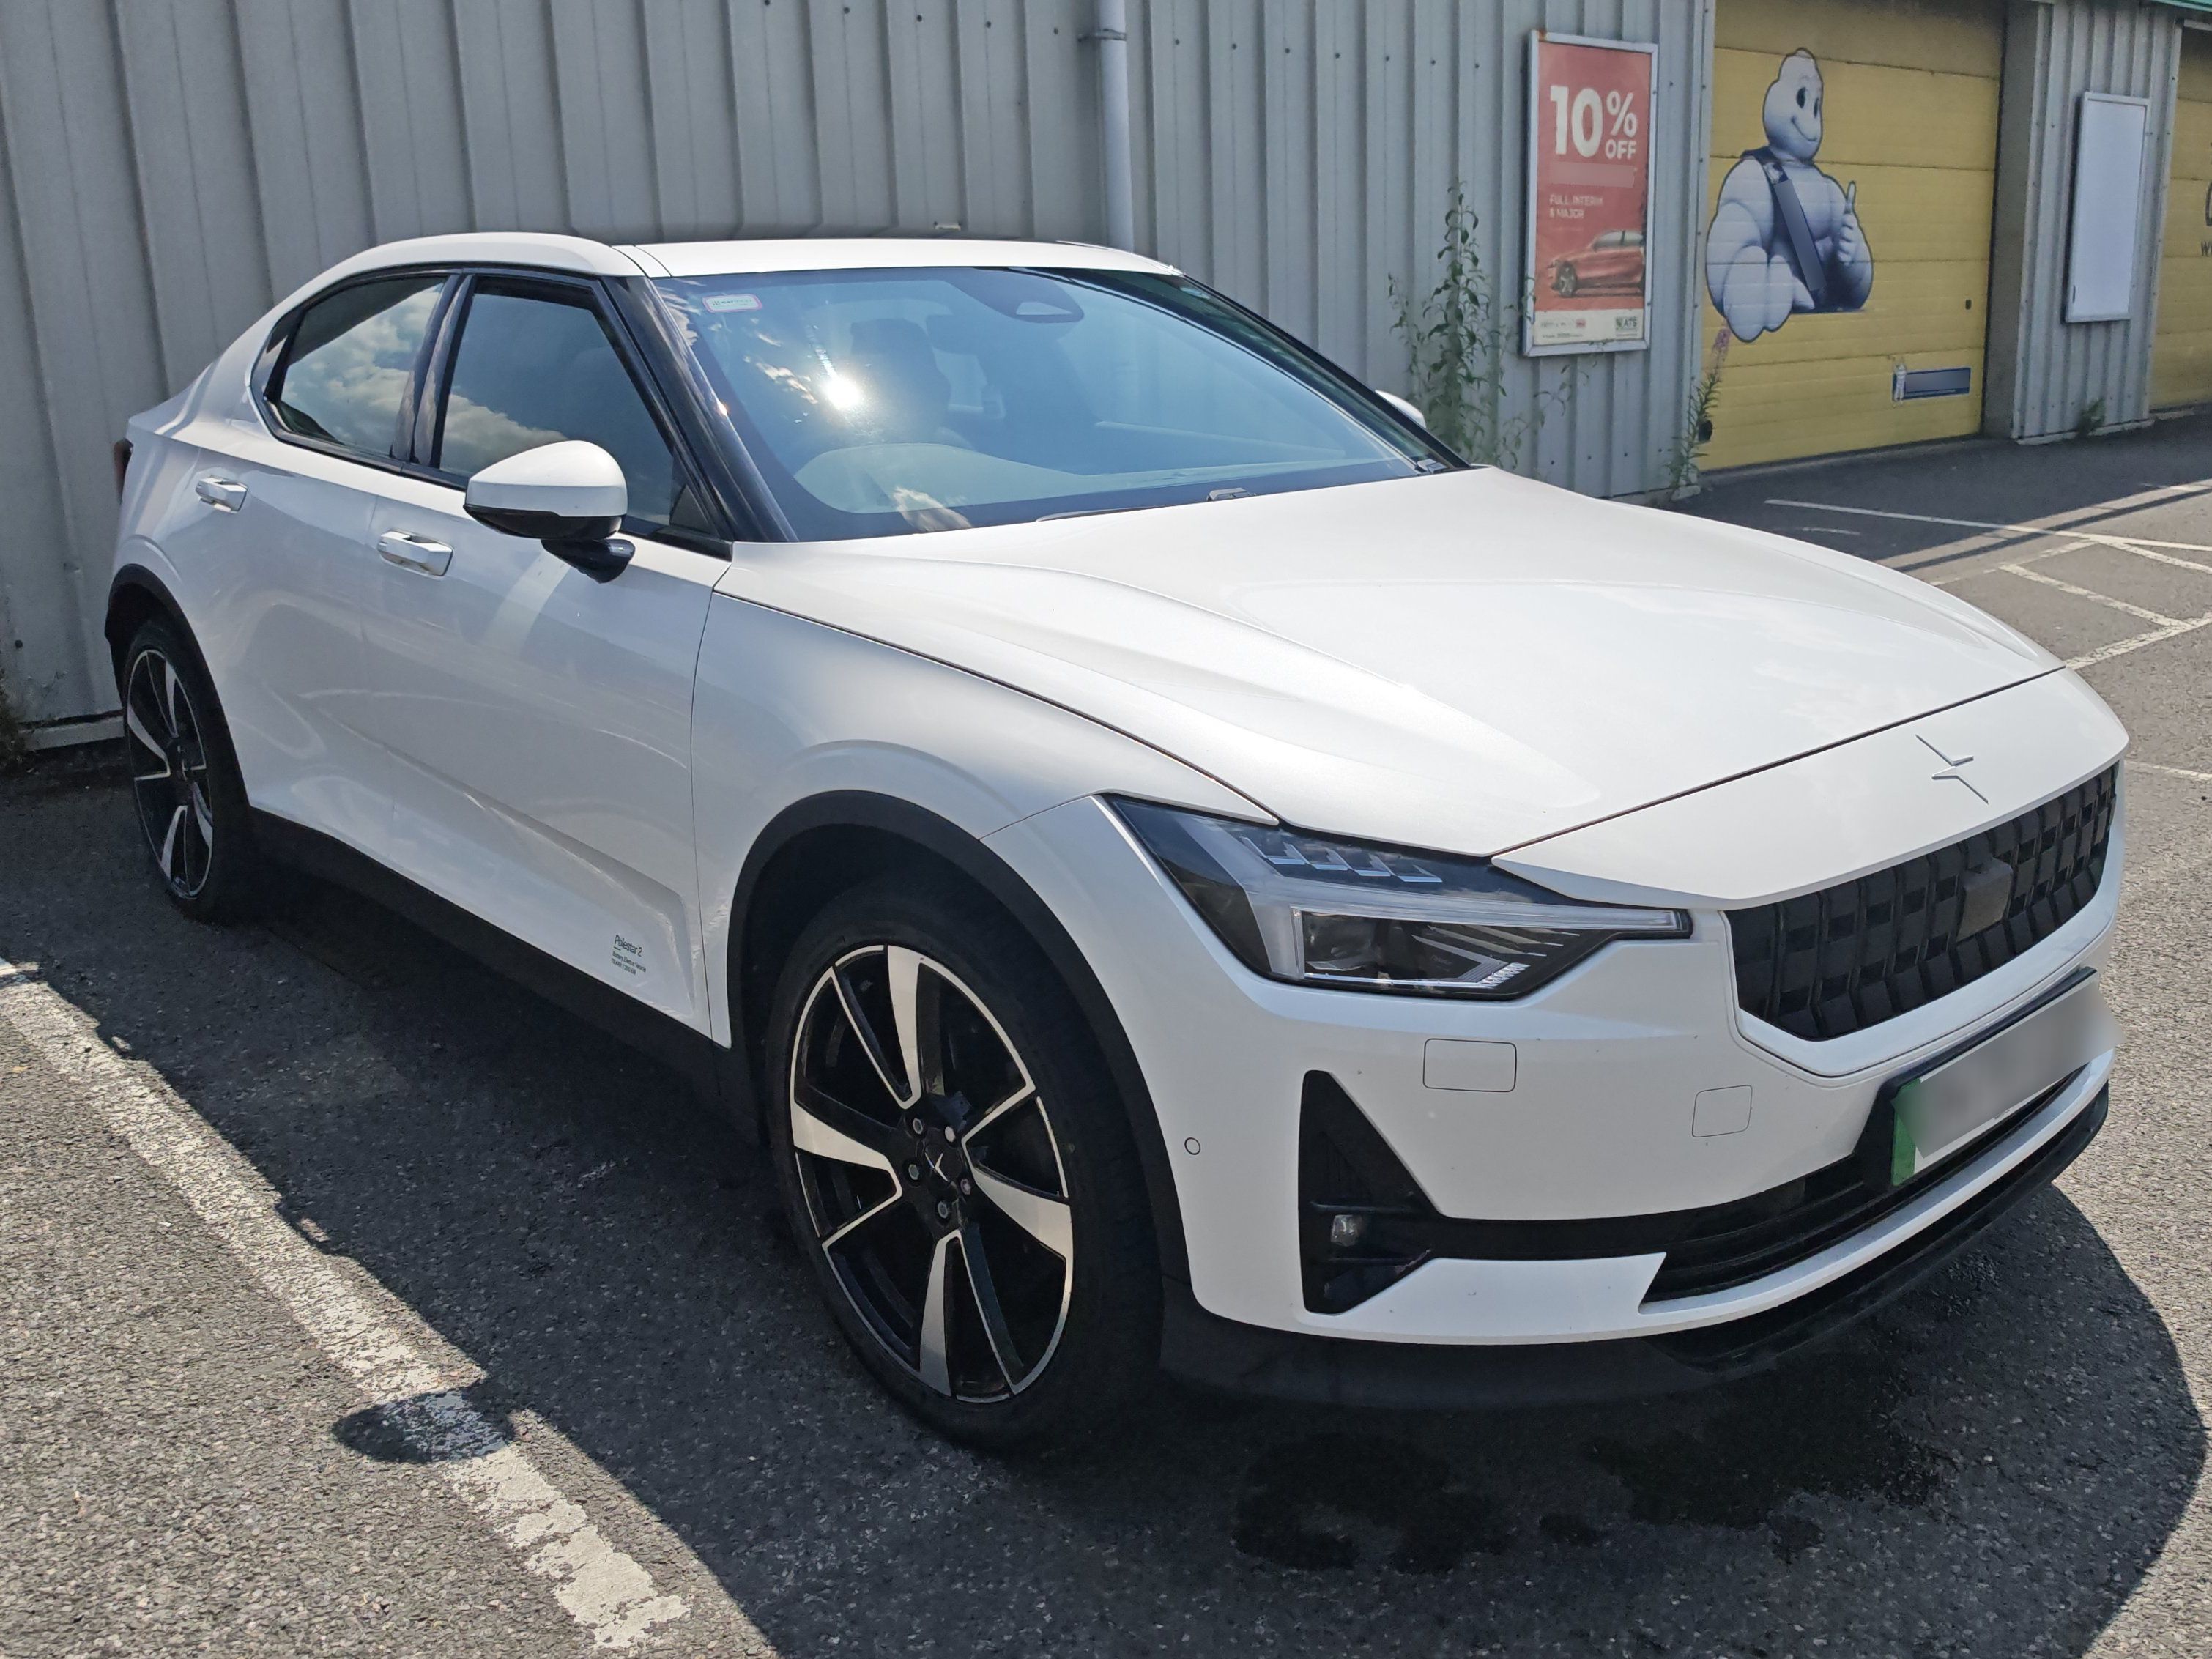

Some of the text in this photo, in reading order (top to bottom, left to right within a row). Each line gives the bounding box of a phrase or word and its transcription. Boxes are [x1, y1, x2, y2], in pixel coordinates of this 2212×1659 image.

[1550, 85, 1638, 157] 10%
[1605, 138, 1637, 160] OFF
[1549, 194, 1569, 206] FULL
[615, 935, 642, 957] Polestar 2
